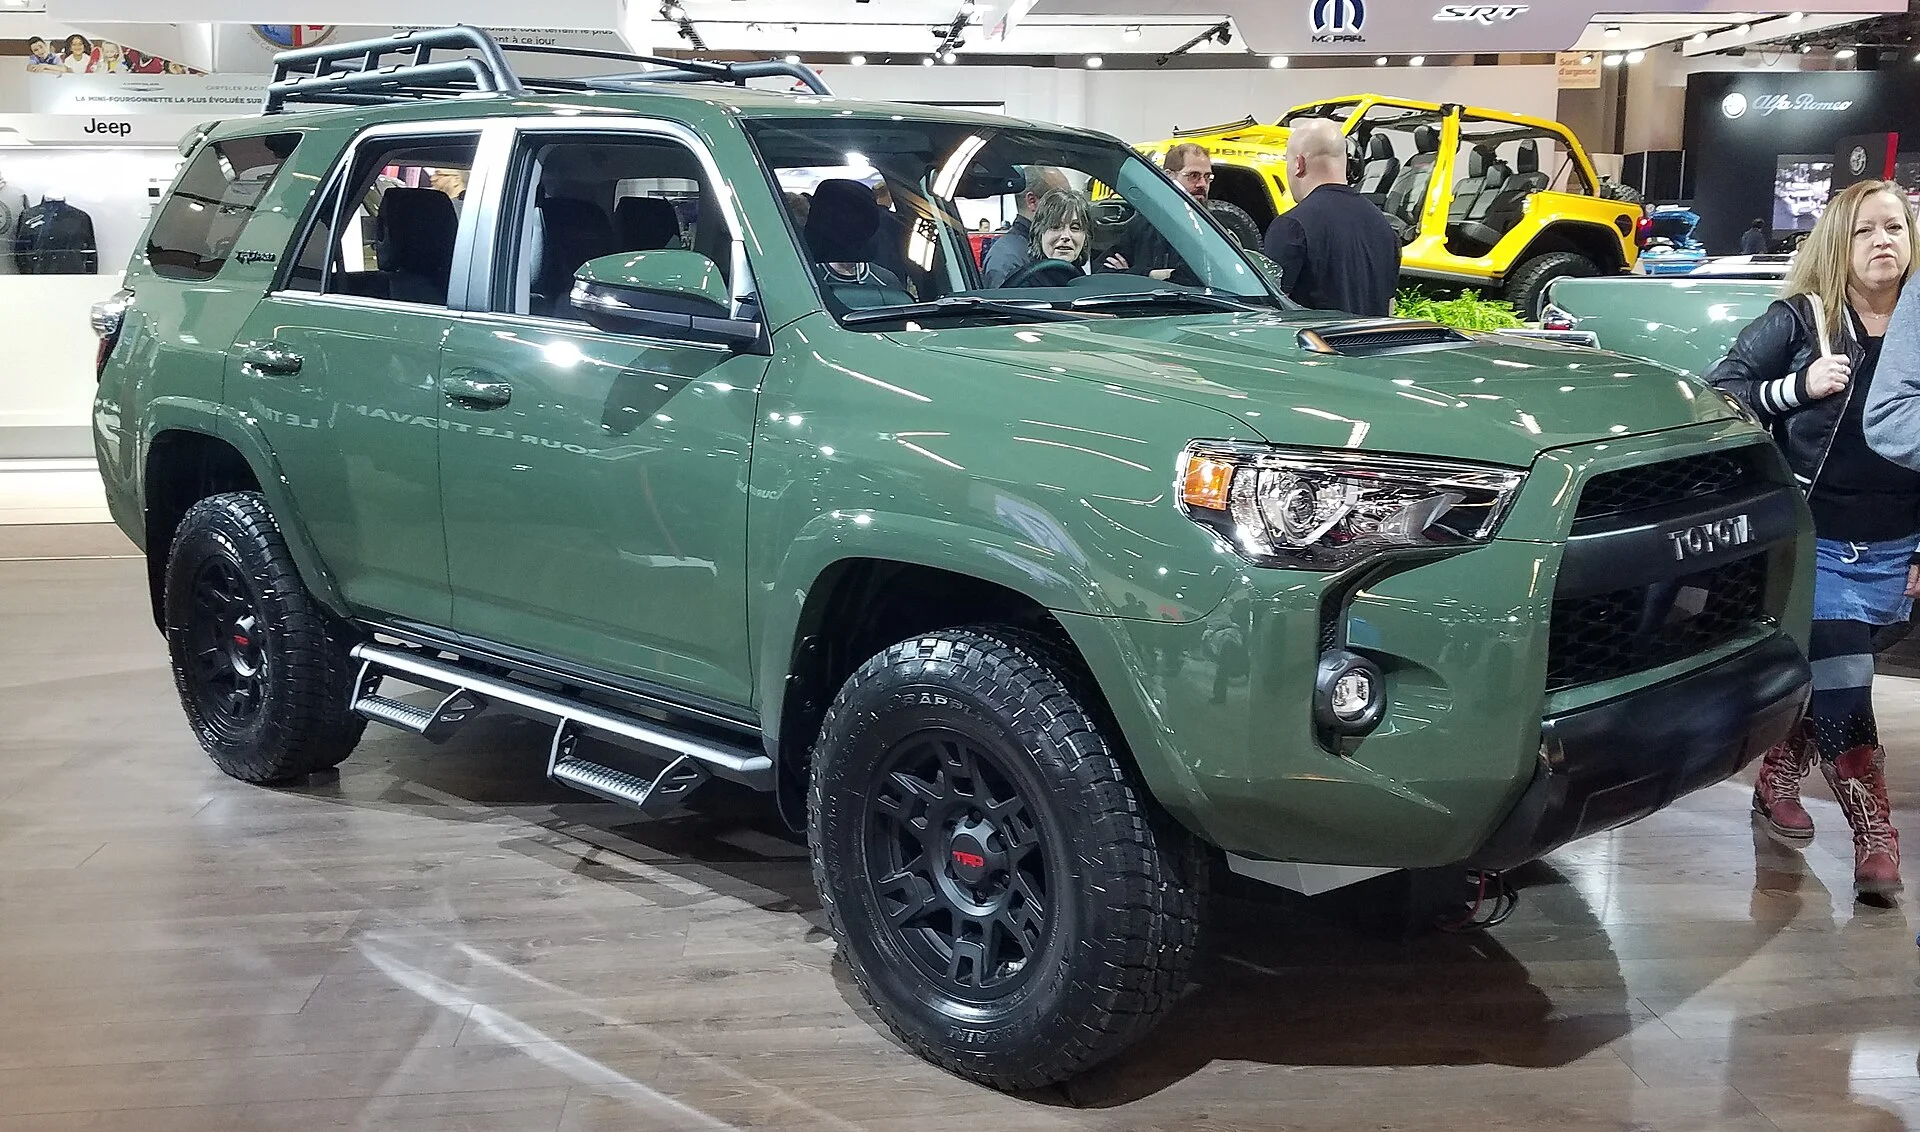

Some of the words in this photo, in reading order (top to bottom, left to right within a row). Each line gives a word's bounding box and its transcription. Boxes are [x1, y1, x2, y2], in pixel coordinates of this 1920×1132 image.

[1433, 5, 1529, 26] SRT
[521, 36, 533, 44] ce
[535, 36, 556, 46] jour
[1752, 94, 1794, 117] Alfa
[1791, 93, 1853, 111] Romeo
[84, 118, 132, 137] Jeep
[1667, 514, 1756, 561] TOYOTA
